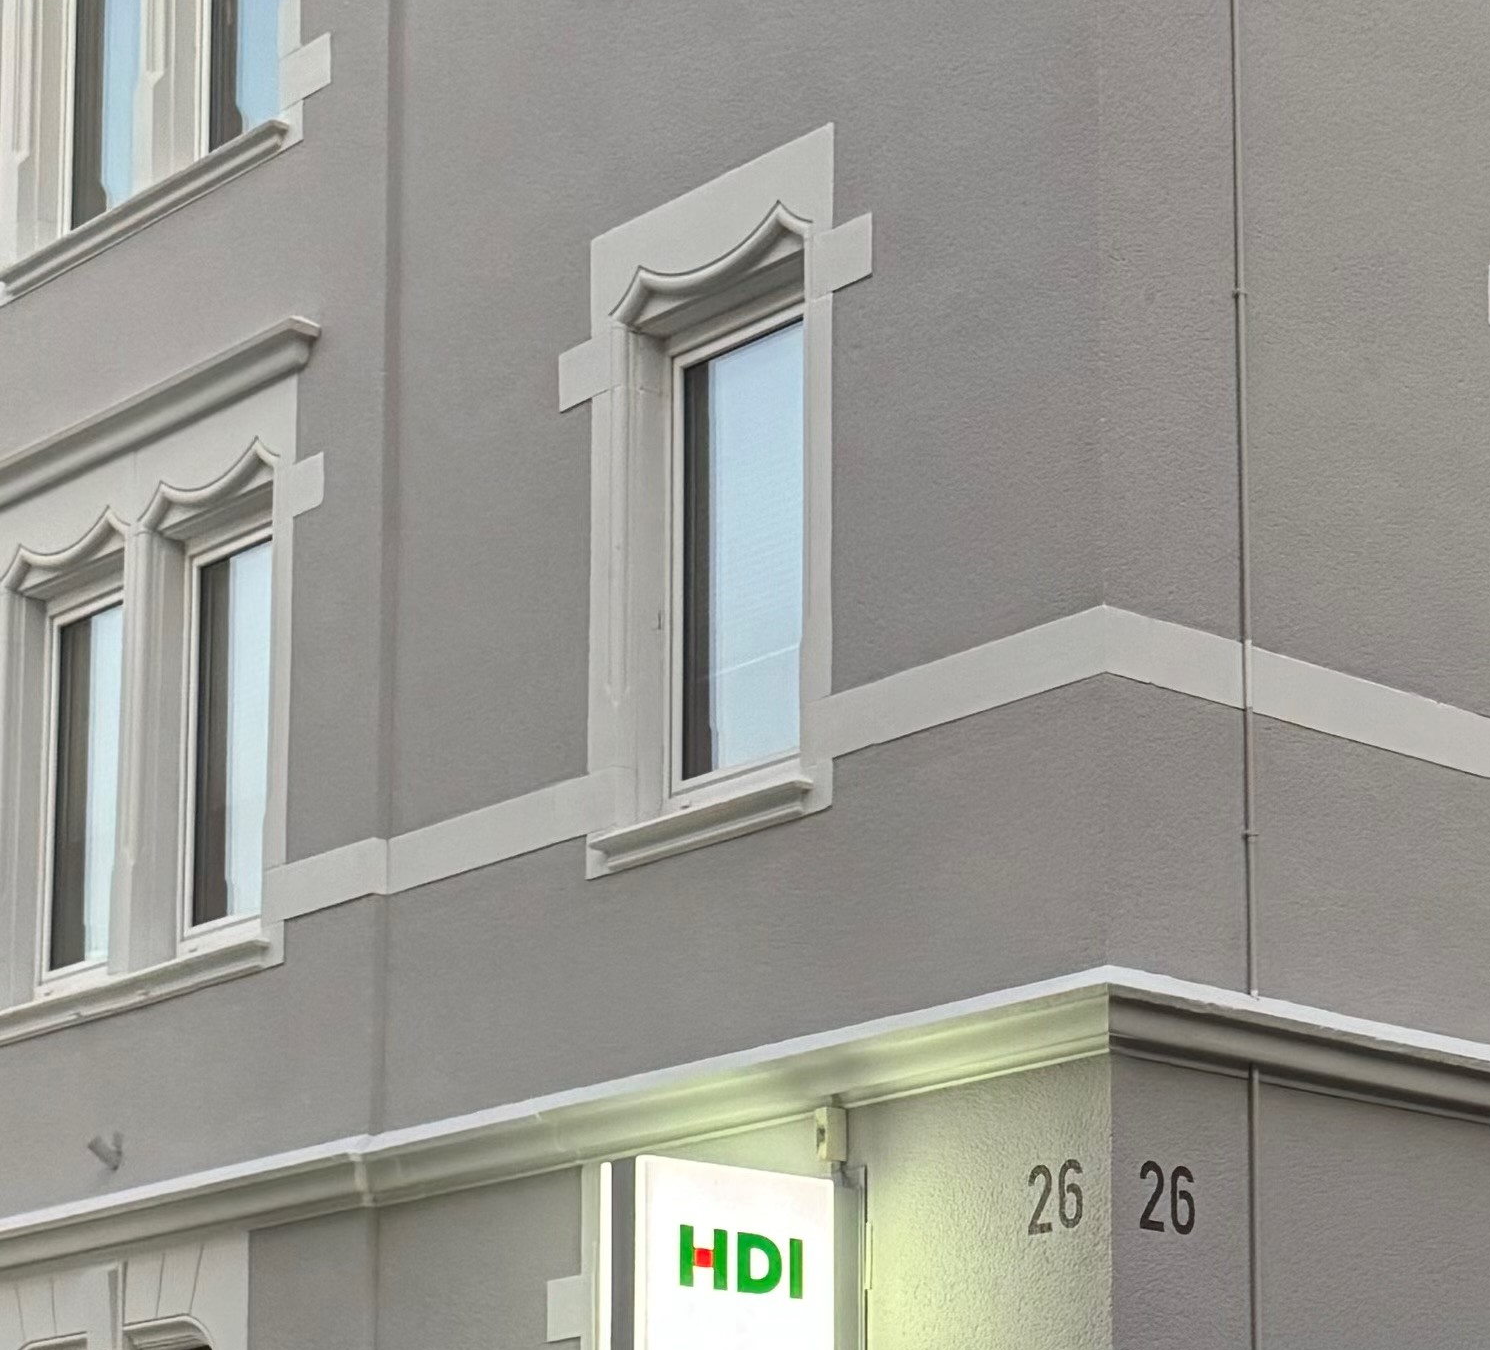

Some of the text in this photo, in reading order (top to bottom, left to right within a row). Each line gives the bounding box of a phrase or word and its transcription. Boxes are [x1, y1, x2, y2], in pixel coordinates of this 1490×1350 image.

[1027, 1159, 1083, 1236] 26
[1138, 1160, 1196, 1236] 26
[680, 1224, 803, 1299] HDI
